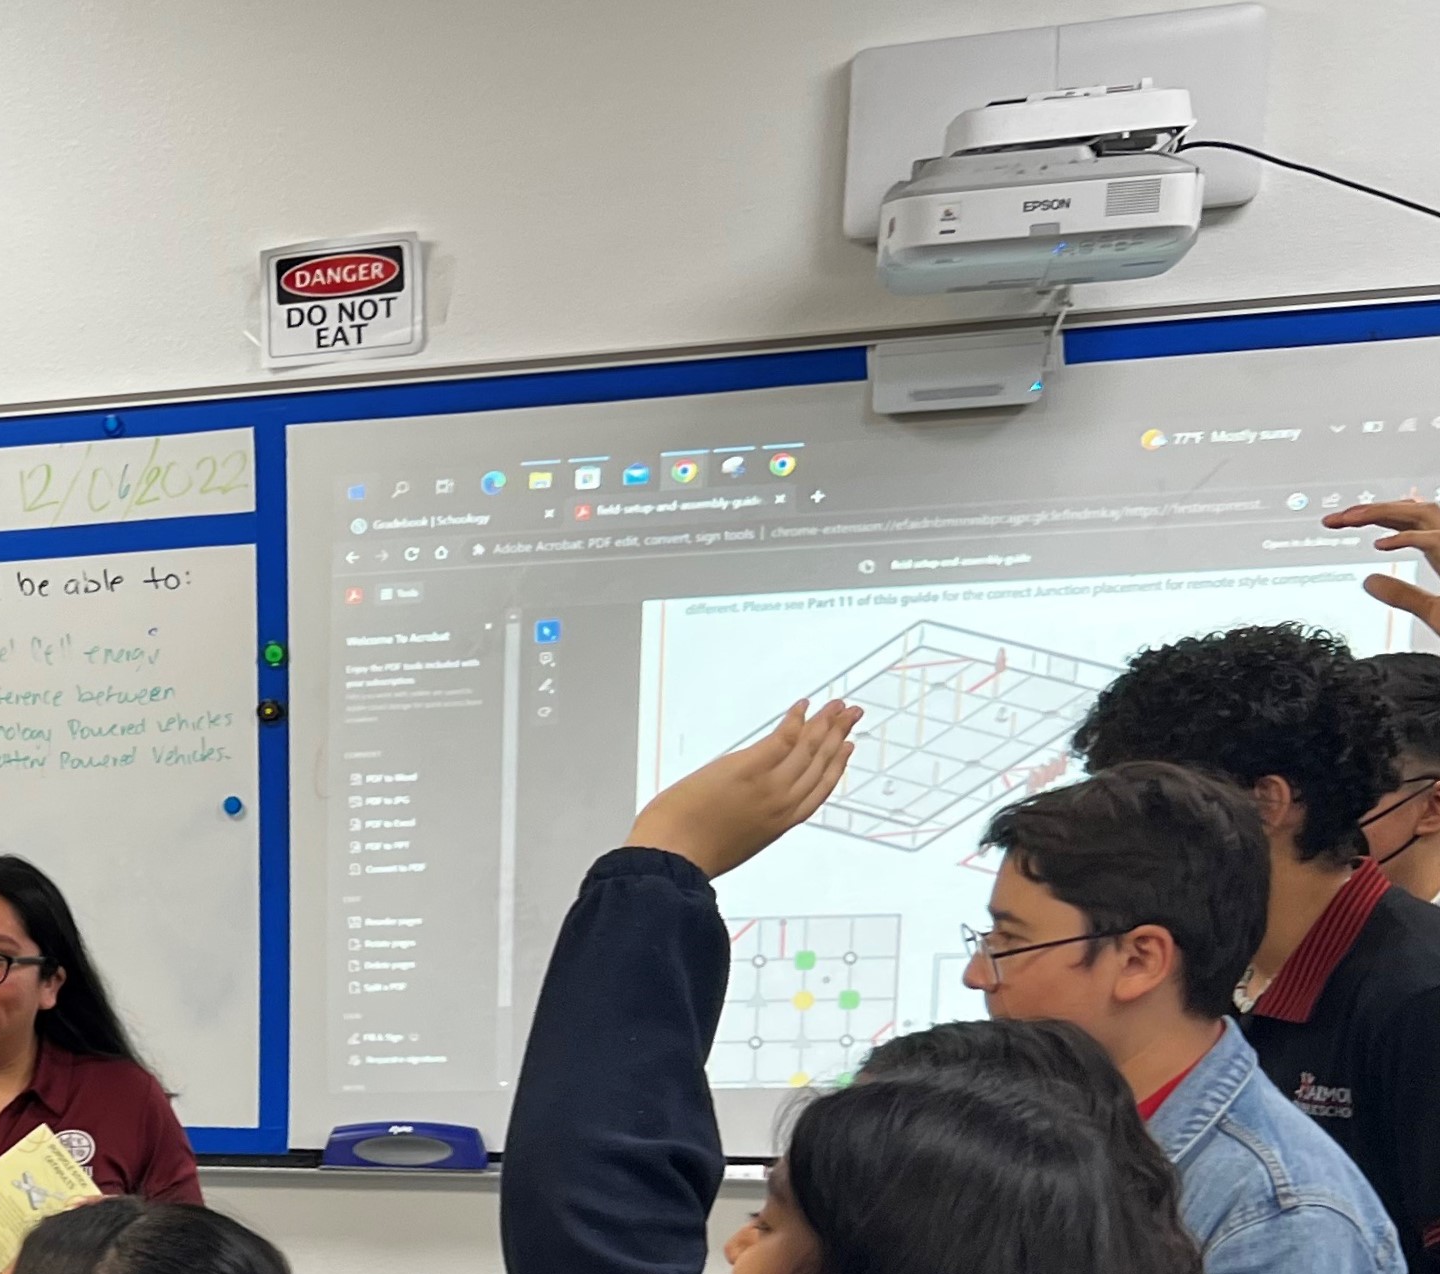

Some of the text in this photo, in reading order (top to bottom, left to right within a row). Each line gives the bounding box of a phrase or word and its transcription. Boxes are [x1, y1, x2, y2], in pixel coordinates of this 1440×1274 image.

[1023, 198, 1071, 212] EPSON
[295, 262, 384, 288] DANGER
[287, 297, 398, 328] DO NOT
[316, 323, 368, 348] EAT
[1211, 428, 1258, 444] Mostly
[1260, 427, 1303, 442] sunny
[493, 541, 533, 555] Adobe
[588, 536, 612, 549] PDF
[614, 534, 640, 548] edit,
[643, 531, 692, 546] convert,
[695, 530, 722, 545] sign
[724, 528, 755, 541] tools
[17, 571, 49, 597] be
[64, 569, 124, 595] able
[143, 566, 191, 590] to:
[742, 600, 781, 613] Please
[784, 601, 805, 611] see
[808, 596, 835, 610] Part
[839, 596, 853, 607] 11
[857, 594, 872, 607] of
[874, 593, 898, 605] this
[901, 590, 939, 607] guide
[942, 590, 960, 602] for
[963, 588, 984, 600] the
[987, 586, 1032, 600] correct
[1034, 584, 1090, 598] Junction
[1093, 581, 1162, 598] placement
[1166, 578, 1184, 591] for
[1187, 576, 1233, 590] remote
[1238, 574, 1271, 589] style
[1272, 571, 1357, 587] competition.
[76, 684, 176, 706] between
[67, 718, 146, 740] Powered
[60, 746, 137, 770] Powered
